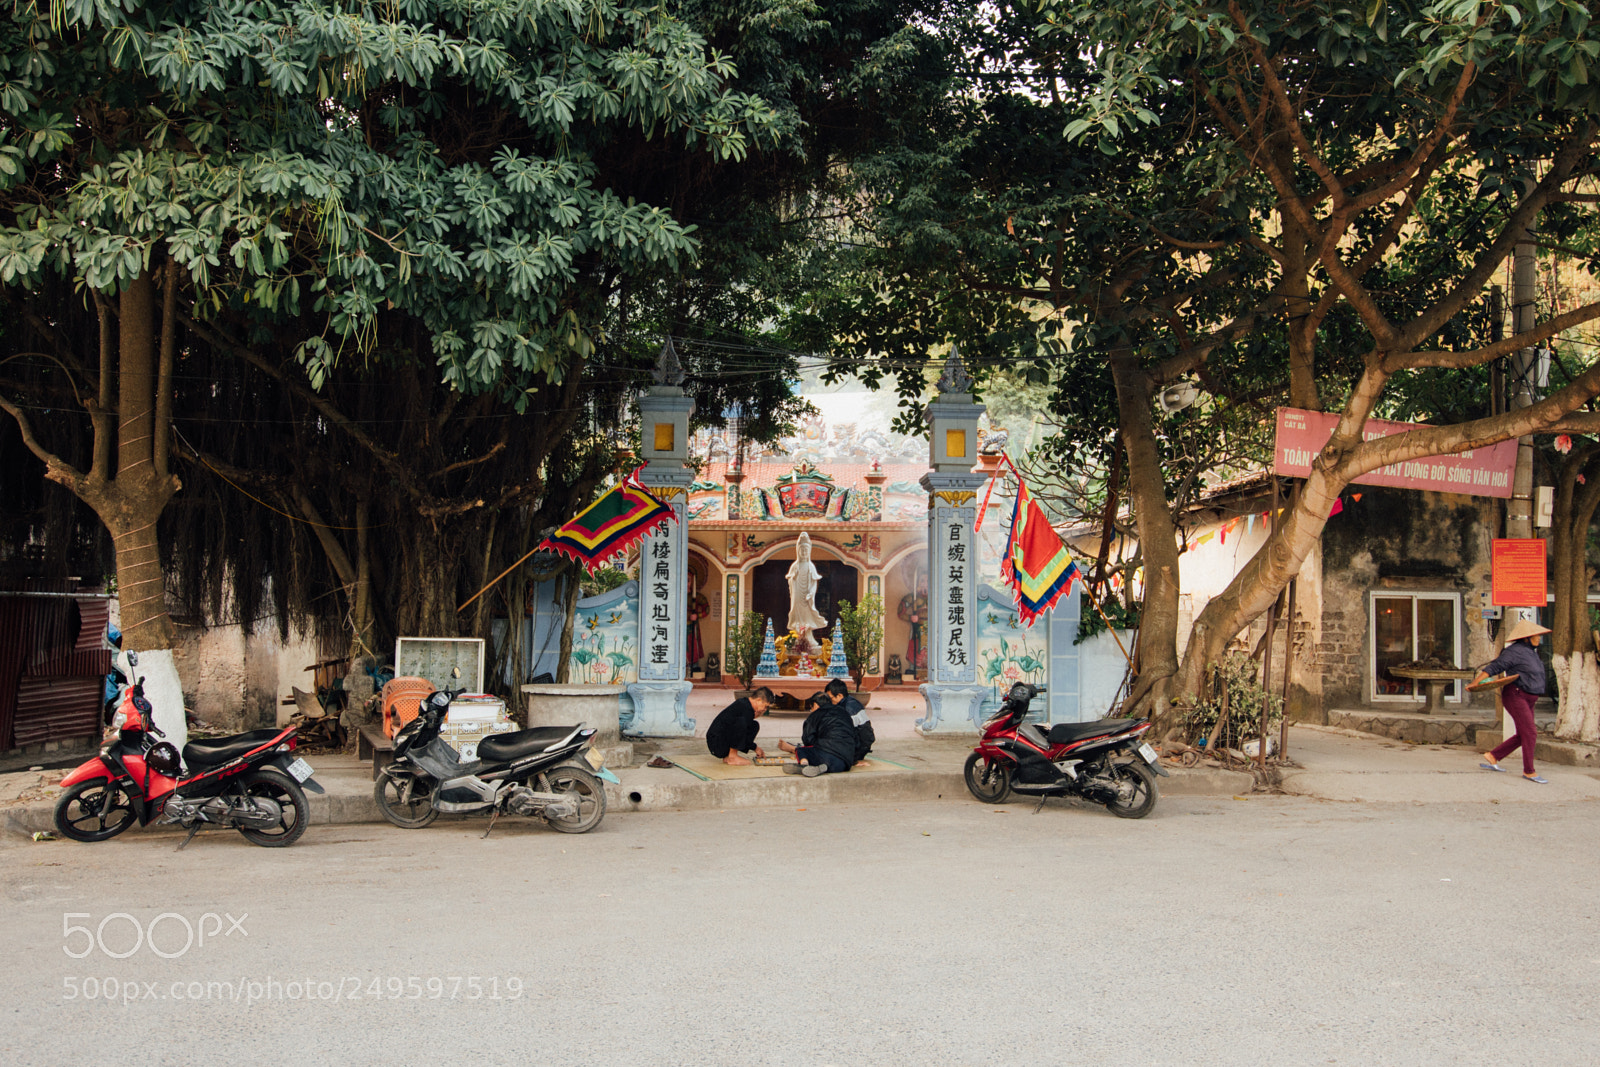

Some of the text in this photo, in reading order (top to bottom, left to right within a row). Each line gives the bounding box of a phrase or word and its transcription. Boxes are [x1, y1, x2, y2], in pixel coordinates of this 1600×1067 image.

[1283, 446, 1310, 467] TOÀN
[1404, 462, 1430, 481] DỰNG
[1430, 461, 1446, 482] ĐỜI
[1447, 462, 1471, 484] SỐNG
[1473, 467, 1490, 486] VĂN
[1491, 469, 1508, 488] HOÁ
